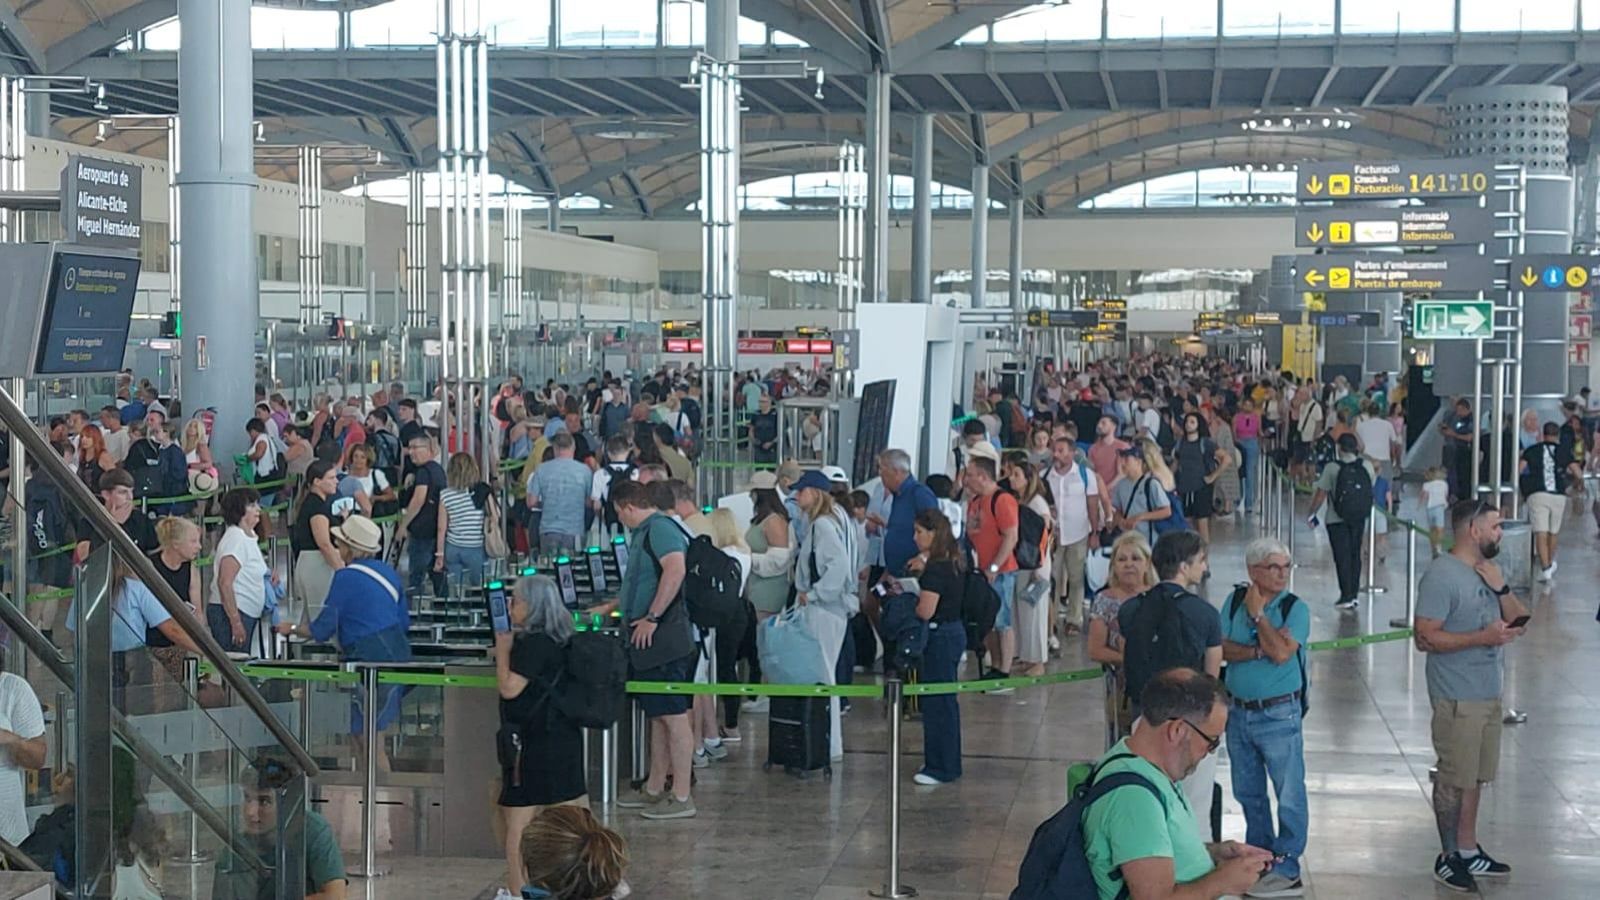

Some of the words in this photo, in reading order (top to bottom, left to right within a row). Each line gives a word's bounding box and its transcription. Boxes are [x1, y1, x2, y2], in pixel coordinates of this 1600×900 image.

[78, 163, 118, 186] Aeropuerto
[120, 170, 129, 187] de
[1354, 183, 1405, 194] Facturación
[78, 191, 127, 213] Alicante-Elche
[1402, 212, 1450, 221] Informació
[77, 215, 102, 237] Miguel
[103, 219, 140, 238] Hernández
[1402, 231, 1455, 241] Información
[1354, 279, 1385, 288] Puertas
[1388, 279, 1398, 288] de
[1400, 279, 1442, 289] embarque
